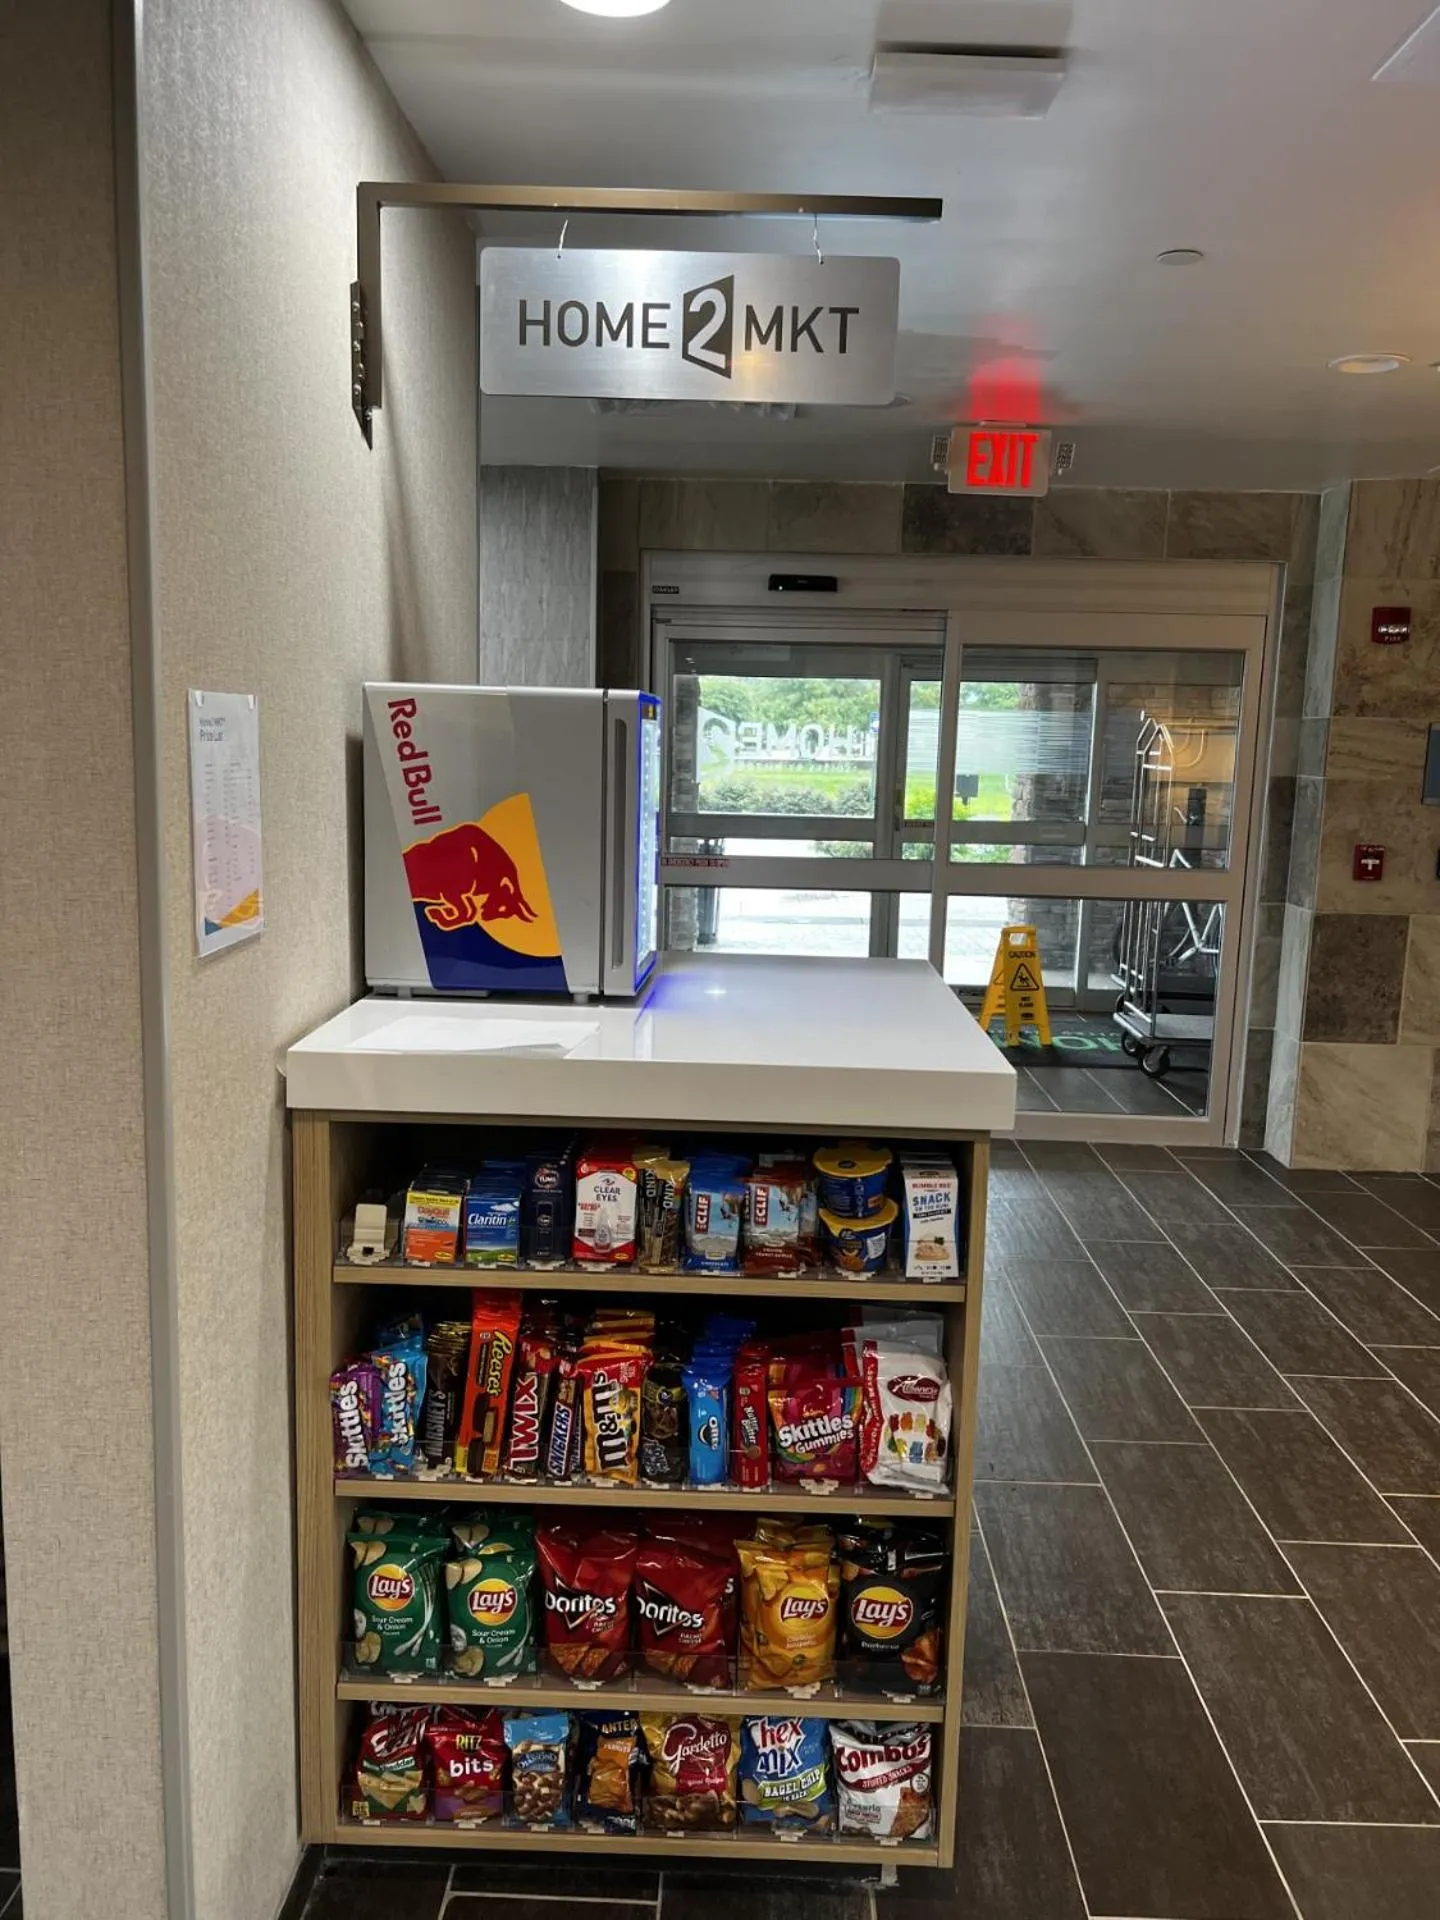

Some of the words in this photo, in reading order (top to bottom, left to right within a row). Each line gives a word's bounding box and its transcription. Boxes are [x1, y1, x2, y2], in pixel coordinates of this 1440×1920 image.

[519, 299, 671, 349] HOME
[744, 304, 860, 354] MKT
[966, 432, 1040, 489] EXIT
[388, 698, 428, 762] Red
[402, 764, 442, 825] Bull
[593, 1186, 621, 1195] CLEAR
[645, 1168, 656, 1198] KIND
[663, 1180, 676, 1209] KIND
[595, 1194, 618, 1202] EYES
[697, 1195, 708, 1223] CLIF
[756, 1187, 769, 1218] CLIF
[912, 1192, 951, 1207] SNACK
[468, 1212, 507, 1226] Claritin
[486, 1330, 513, 1397] Reese's
[339, 1380, 368, 1469] Skittles
[510, 1375, 539, 1470] TWIX
[708, 1416, 720, 1450] OREO
[779, 1415, 854, 1448] Skittles
[548, 1402, 572, 1476] SNICKERS
[796, 1429, 855, 1454] Gummies
[371, 1575, 411, 1600] Lay's
[472, 1590, 515, 1614] Lay's
[545, 1591, 616, 1614] Doritos
[784, 1598, 826, 1620] Lay's
[855, 1599, 909, 1627] Lay's
[456, 1734, 483, 1750] RITZ
[836, 1734, 930, 1773] Combos
[450, 1757, 494, 1778] bits
[757, 1745, 802, 1776] mix
[764, 1782, 800, 1797] BAGEL
[800, 1768, 820, 1790] CHIP
